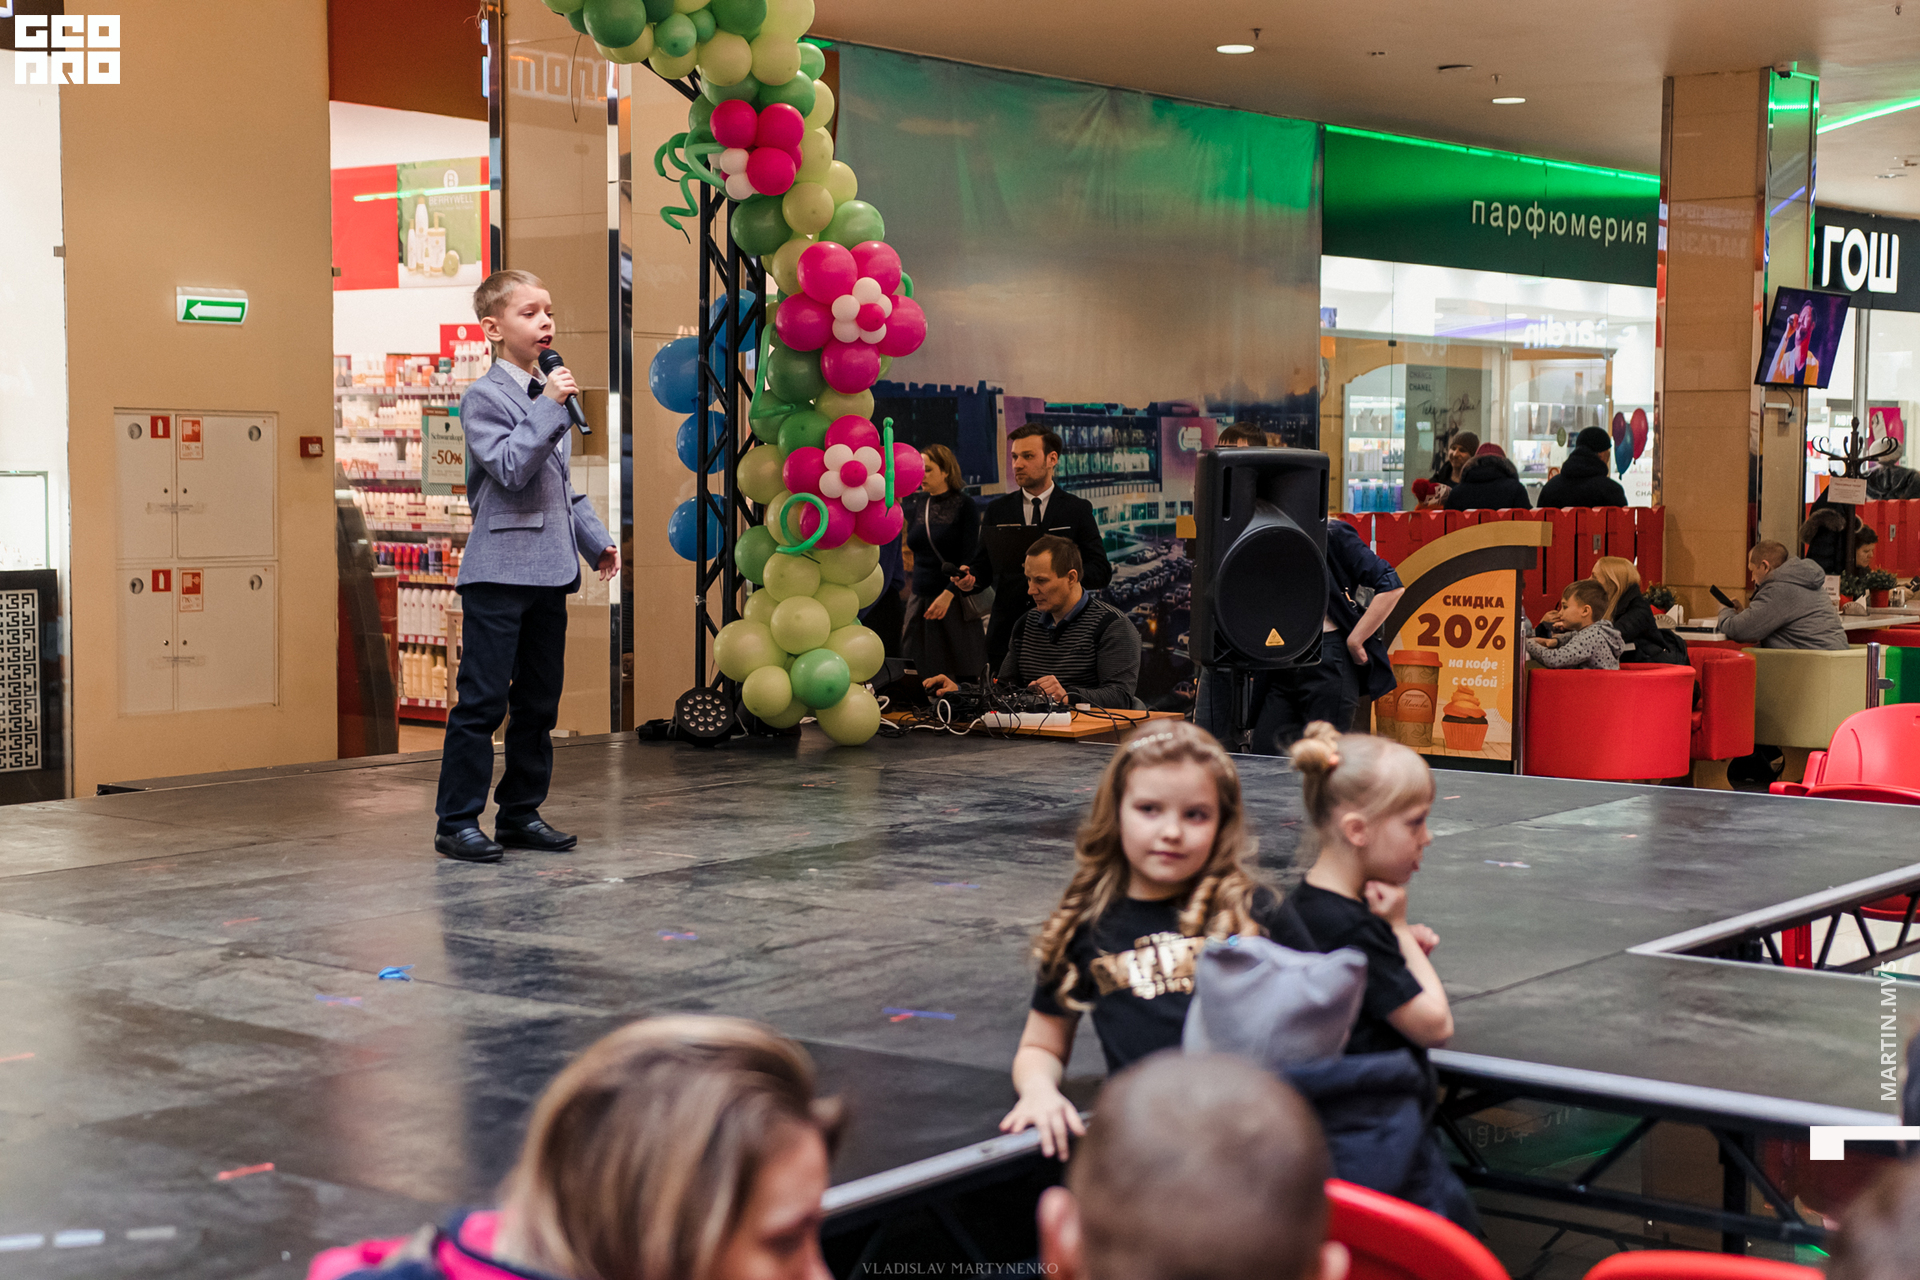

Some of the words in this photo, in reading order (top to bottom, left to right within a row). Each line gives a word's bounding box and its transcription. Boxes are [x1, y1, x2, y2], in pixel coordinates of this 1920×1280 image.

[1472, 200, 1648, 247] парфюмерия
[1821, 225, 1899, 294] ГОШ
[1409, 383, 1432, 392] CHANEL
[431, 449, 463, 465] -50%
[1442, 595, 1505, 609] СКИДКА
[1417, 613, 1506, 650] 20%
[1448, 658, 1463, 668] на
[1465, 657, 1498, 672] кофе
[1452, 677, 1459, 685] с
[1460, 675, 1498, 688] собой
